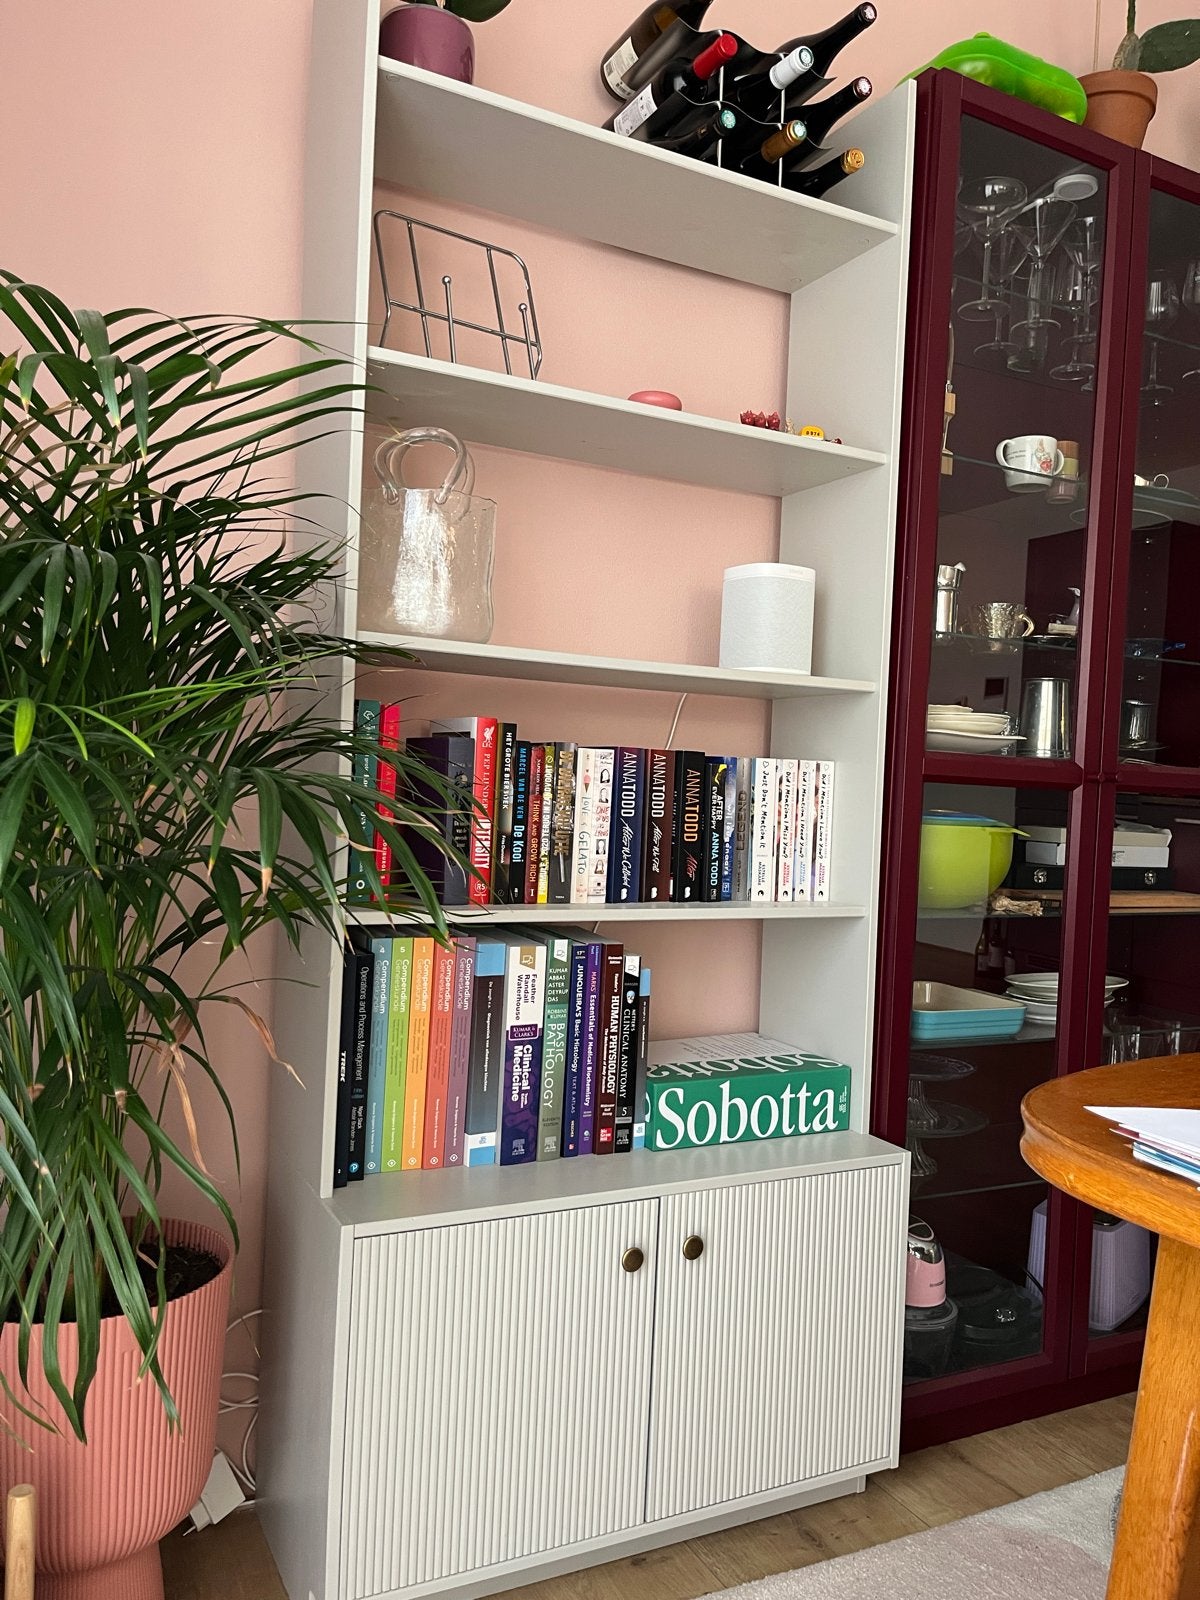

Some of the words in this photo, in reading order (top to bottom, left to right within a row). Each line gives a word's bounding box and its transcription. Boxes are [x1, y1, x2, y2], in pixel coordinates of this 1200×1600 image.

[559, 750, 574, 766] DE
[482, 772, 490, 812] LIJNDER
[543, 764, 552, 806] ZANDVOORT
[582, 796, 591, 816] LOVE
[736, 790, 747, 850] LEGEND
[474, 818, 492, 869] INTENSITY
[512, 841, 524, 862] Kooi
[514, 826, 524, 837] De
[530, 838, 538, 862] GROW
[540, 838, 549, 856] 2020
[620, 818, 634, 847] After
[651, 822, 663, 847] After
[578, 831, 590, 874] GELATO
[622, 848, 630, 859] We
[652, 847, 660, 857] We
[684, 850, 698, 881] After
[539, 862, 548, 895] FORMULE
[621, 860, 631, 887] Collided
[710, 861, 718, 886] TODD
[359, 967, 370, 1000] Operations
[379, 960, 389, 1014] Compendium
[394, 960, 402, 1011] Geneeskunde
[400, 959, 409, 1012] Compendium
[415, 959, 423, 1010] Geneeskunde
[421, 959, 430, 1012] Compendium
[438, 960, 446, 1010] Geneeskunde
[444, 959, 453, 1012] Compendium
[457, 958, 466, 1009] Geneeskunde
[464, 958, 472, 1010] Compendium
[576, 964, 584, 1017] JUNQUEIRA'S
[357, 1014, 366, 1039] Process
[588, 994, 596, 1032] Essentials
[610, 996, 619, 1032] HUMAN
[622, 1009, 630, 1051] CLINICAL
[354, 1040, 366, 1081] Management
[555, 1023, 565, 1063] BASIC
[571, 1039, 580, 1072] Histology
[511, 1045, 523, 1101] Medicine
[522, 1044, 532, 1090] Clinical
[544, 1024, 556, 1108] PATHOLOGY
[607, 1035, 619, 1094] PHYSIOLOGY
[620, 1054, 628, 1098] ANATOMY
[583, 1067, 592, 1106] Biochemistry
[622, 1107, 627, 1116] 5
[656, 1080, 839, 1149] Sobotta
